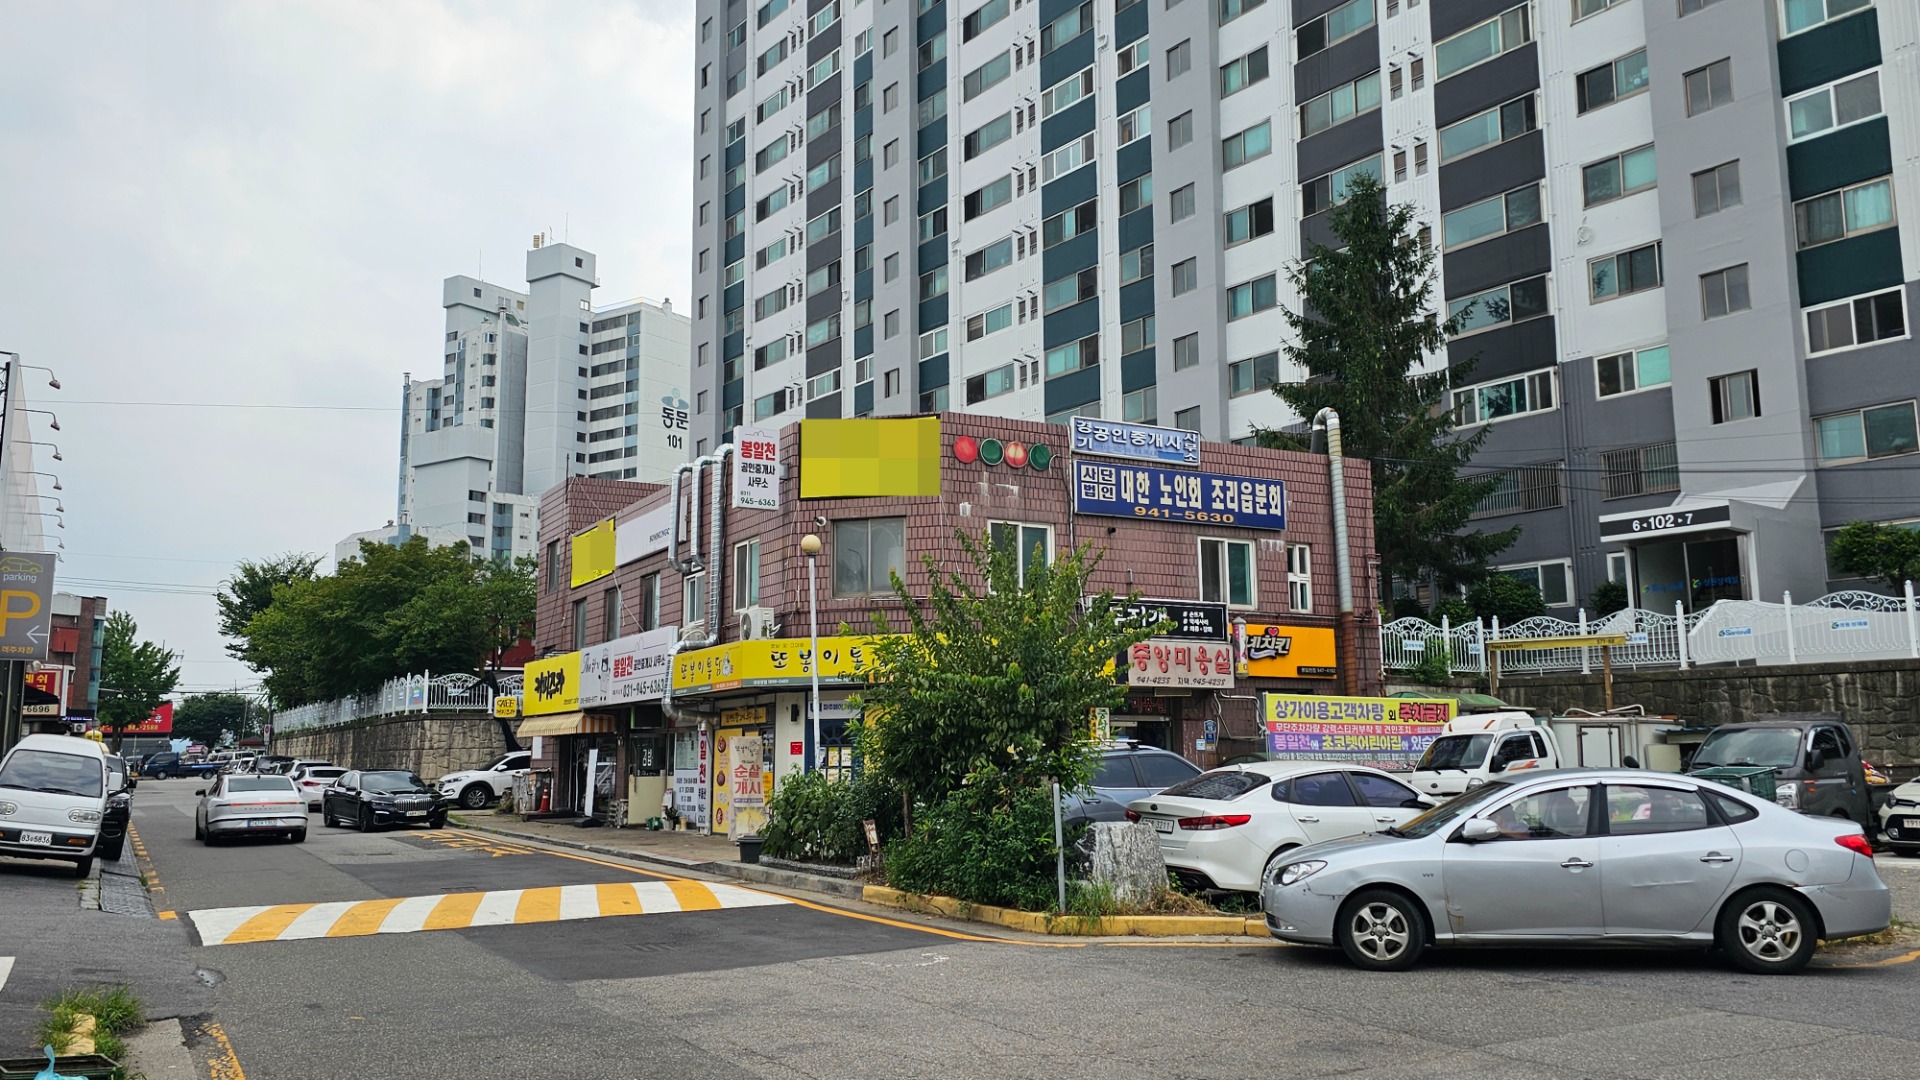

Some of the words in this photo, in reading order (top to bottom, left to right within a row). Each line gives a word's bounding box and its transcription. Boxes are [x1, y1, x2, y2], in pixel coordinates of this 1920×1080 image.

[662, 406, 689, 430] 동문
[667, 434, 682, 450] 101
[741, 440, 776, 461] 봉일천
[1093, 428, 1182, 450] 공인중개사
[1184, 432, 1198, 463] 사무소
[741, 462, 776, 475] 공인중개사
[748, 477, 769, 489] 사무소
[1120, 469, 1150, 504] 대한
[1160, 473, 1202, 510] 노인회
[1211, 479, 1282, 516] 조리읍분회
[740, 497, 776, 507] 945-6363
[1134, 506, 1235, 524] 941-5630
[1632, 519, 1640, 531] 6
[1649, 514, 1675, 529] 102
[1685, 513, 1693, 525] 7
[3, 573, 37, 583] parking
[0, 590, 41, 637] P
[0, 646, 34, 654] 객주차장
[1132, 643, 1232, 675] 중앙미용실
[613, 655, 633, 678] 봉일천
[633, 657, 653, 671] 공인중개사
[653, 654, 666, 667] 사무소
[622, 678, 664, 698] 031-945-6363
[1275, 700, 1384, 722] 상가이용고객차량
[1388, 710, 1397, 721] 외
[1399, 702, 1449, 723] 주차금지
[1275, 723, 1320, 733] 무단주차차량
[1322, 725, 1373, 735] 강력스티커부착
[1375, 726, 1382, 734] 및
[1384, 726, 1412, 735] 견인조치
[1274, 734, 1319, 751] 봉일천에
[1321, 734, 1408, 751] 초코렛어린이집이
[699, 730, 707, 784] 일천
[734, 764, 761, 778] 순살
[734, 781, 762, 795] 개시
